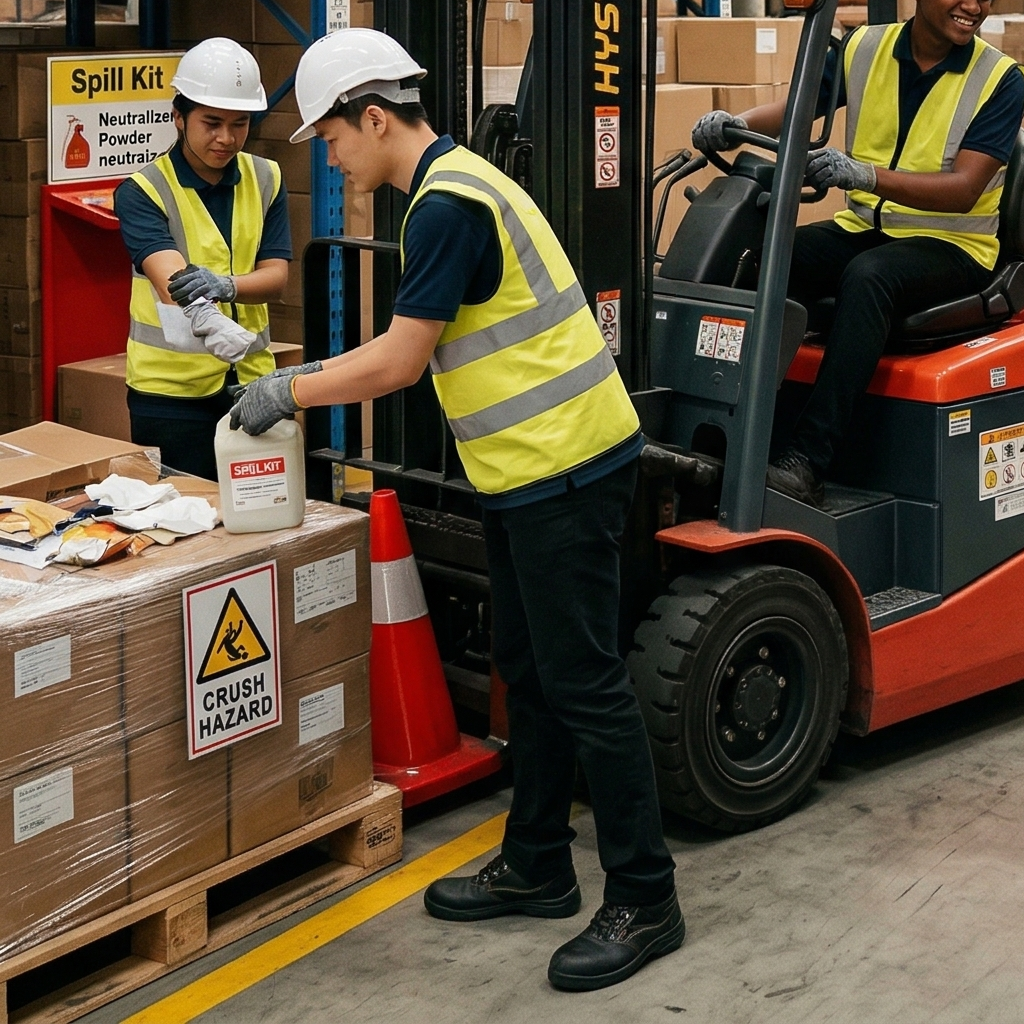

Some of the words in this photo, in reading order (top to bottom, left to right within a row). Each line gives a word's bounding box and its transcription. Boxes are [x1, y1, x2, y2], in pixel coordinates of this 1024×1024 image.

[71, 66, 123, 99] Spill
[131, 65, 164, 90] Kit
[99, 130, 152, 147] Powder
[202, 672, 265, 712] CRUSH
[199, 695, 273, 740] HAZARD
